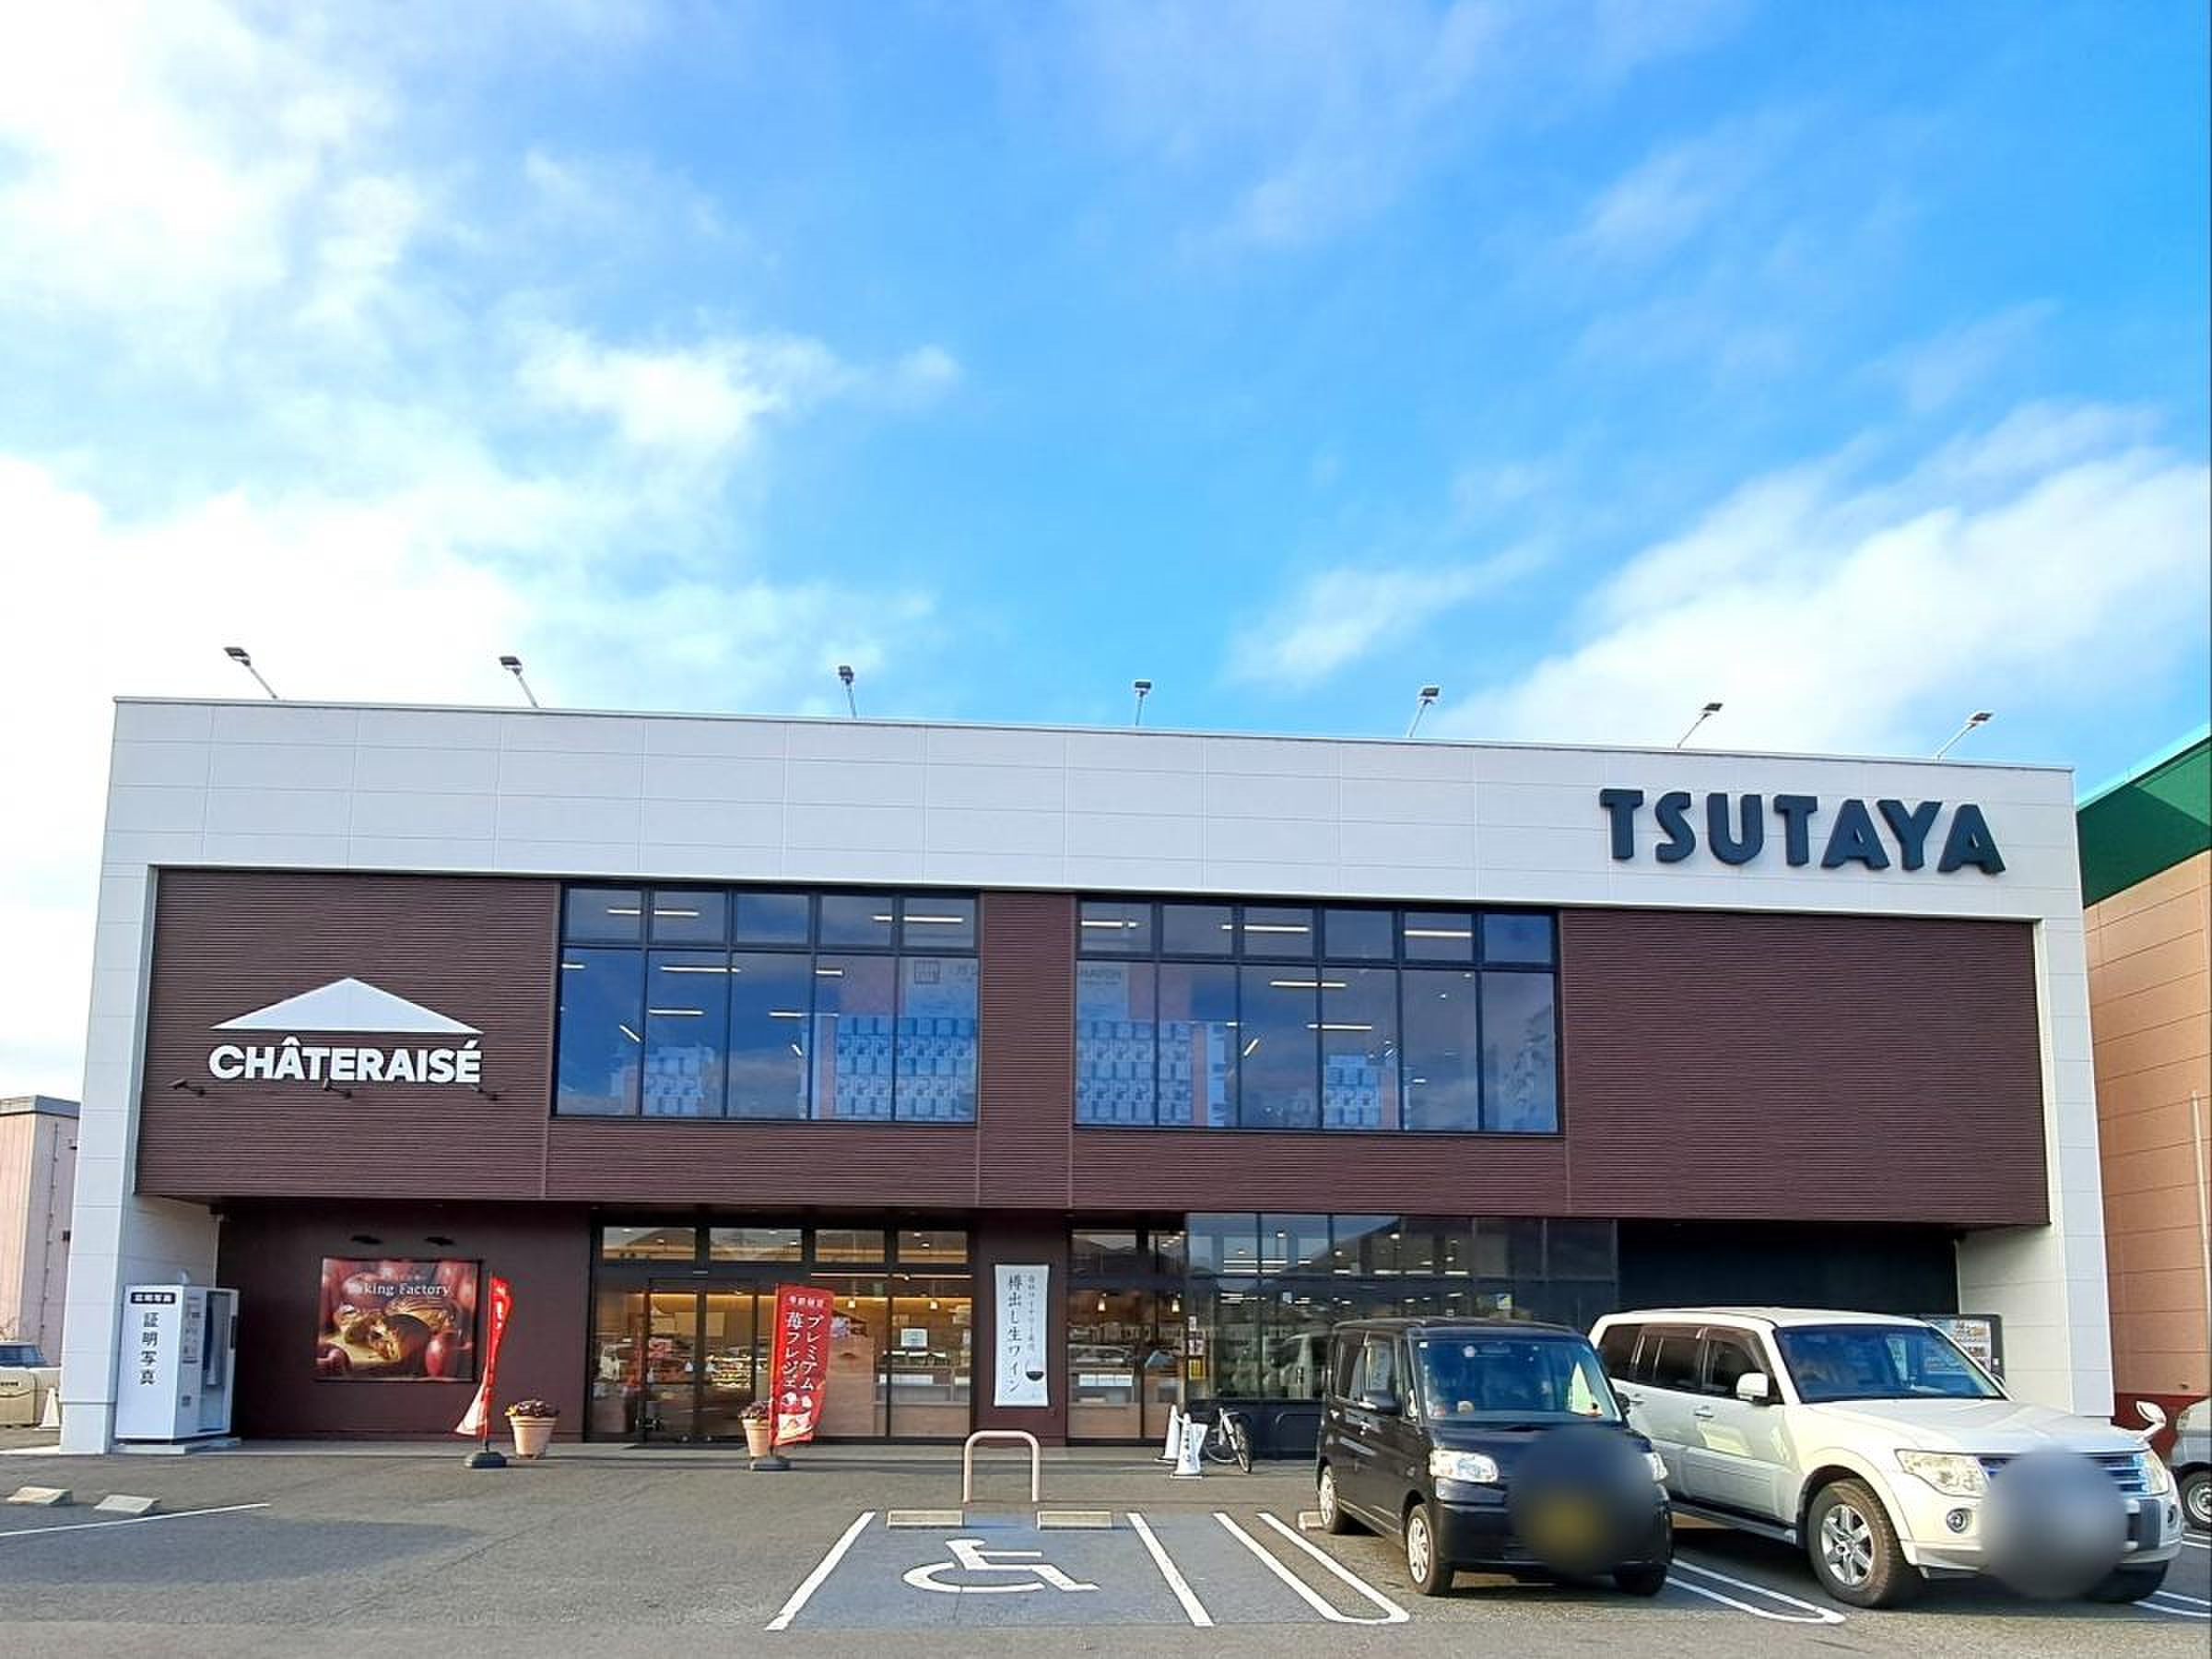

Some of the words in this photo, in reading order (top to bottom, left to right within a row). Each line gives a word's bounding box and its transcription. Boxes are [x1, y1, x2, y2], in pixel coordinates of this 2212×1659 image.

[1599, 789, 2006, 874] TSUTAYA
[208, 1036, 482, 1083] CHÂTERAISÉ
[348, 1282, 394, 1297] king
[399, 1282, 451, 1297] Factory
[140, 1312, 159, 1384] 証明写真
[800, 1314, 824, 1391] プレミアム
[1008, 1273, 1022, 1393] 樽出し生ワイン
